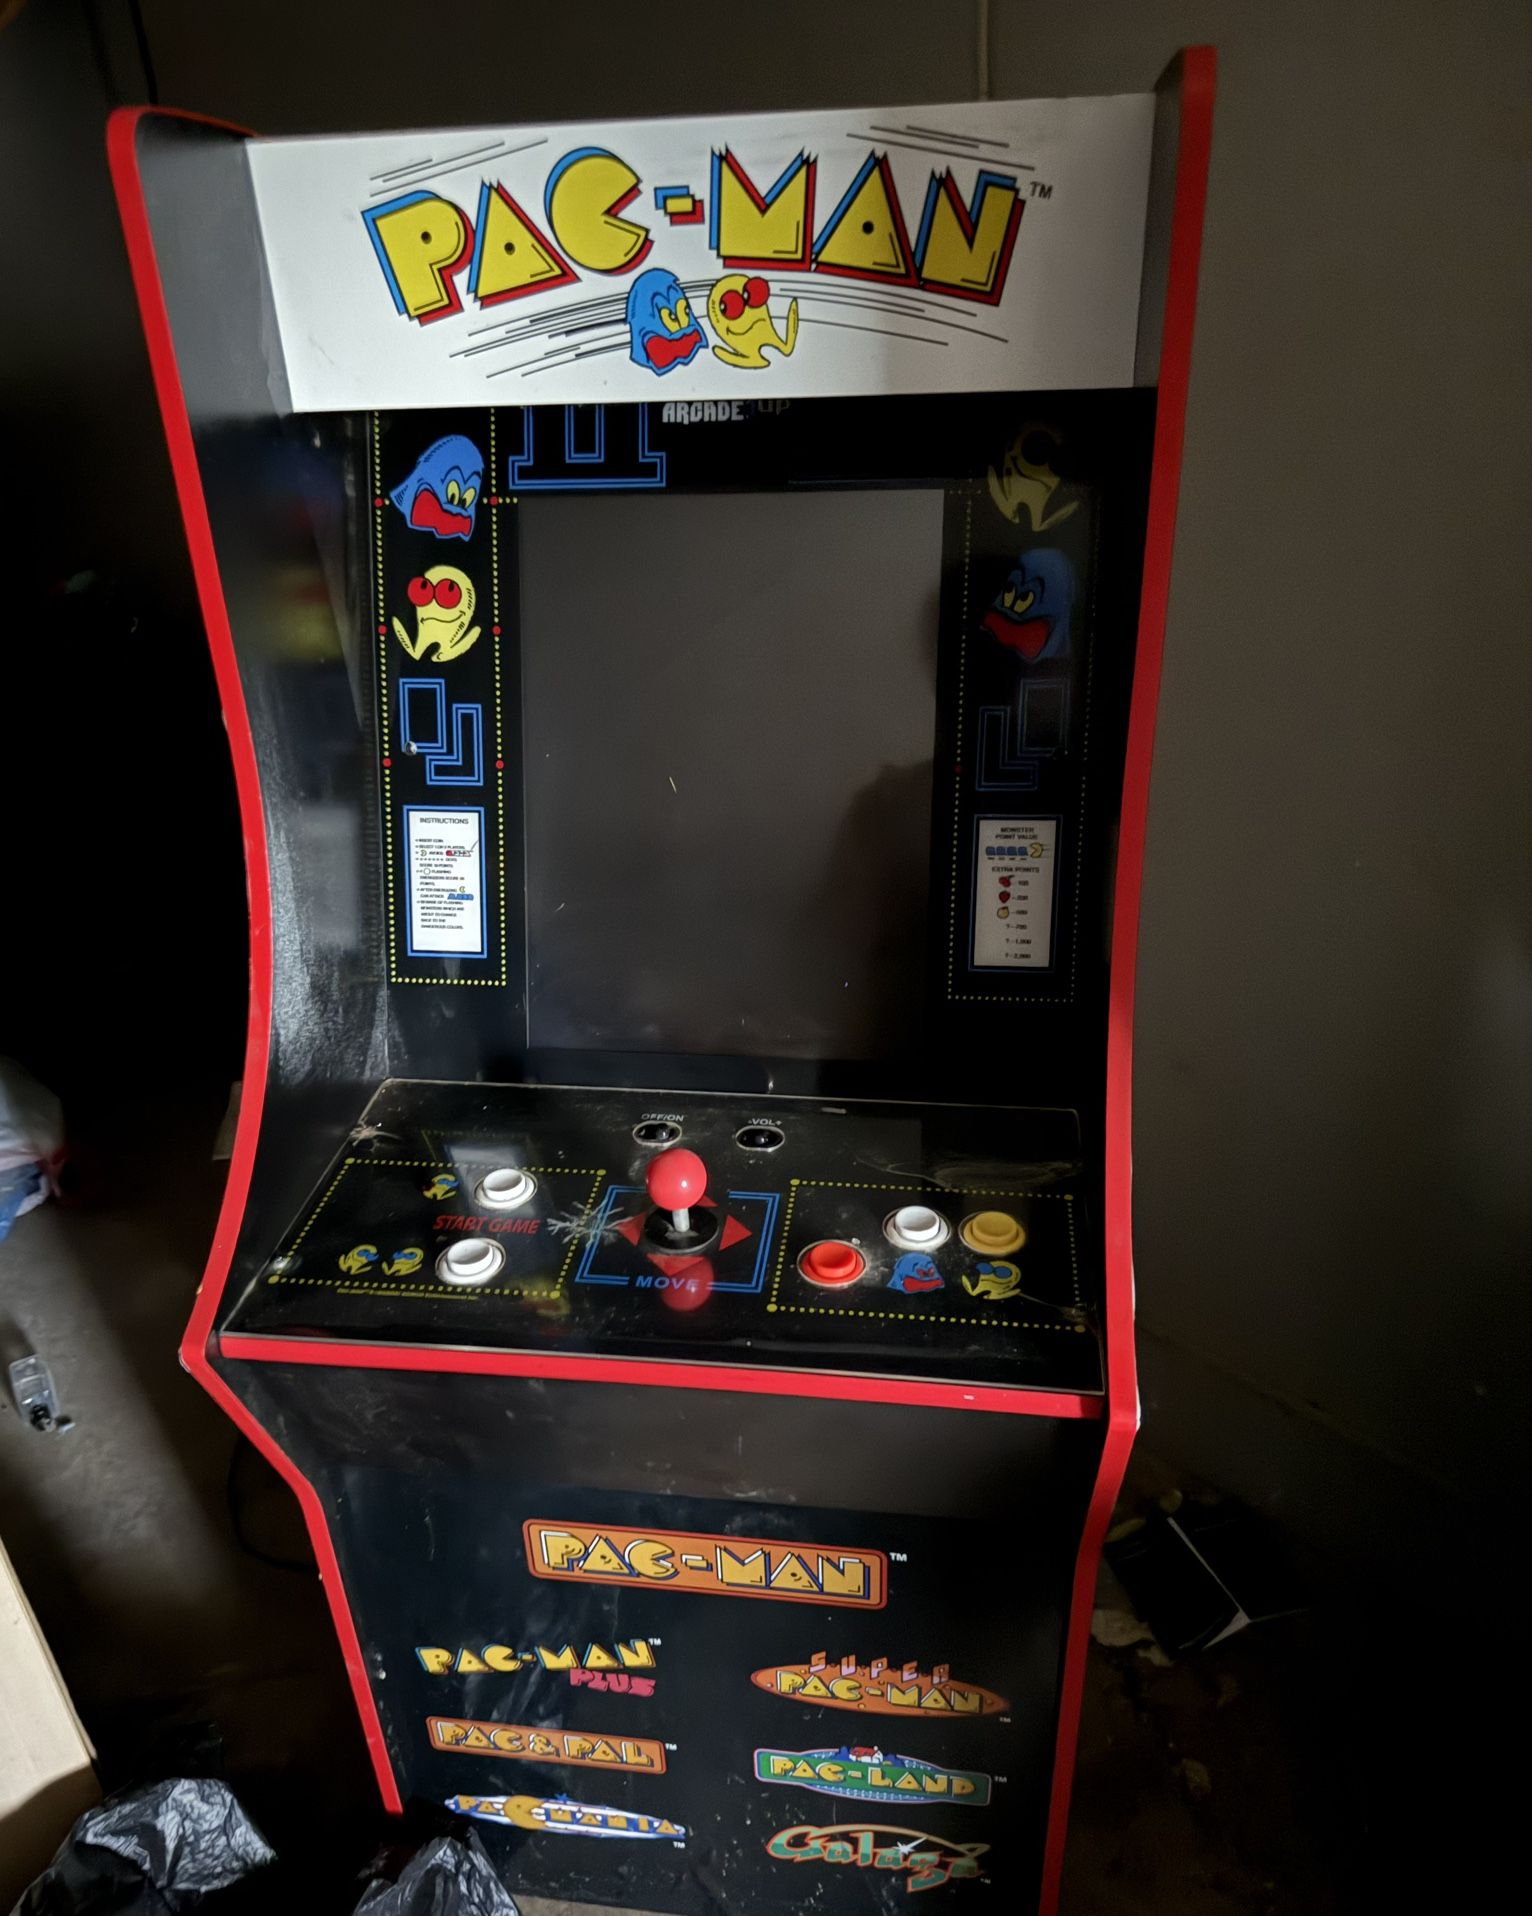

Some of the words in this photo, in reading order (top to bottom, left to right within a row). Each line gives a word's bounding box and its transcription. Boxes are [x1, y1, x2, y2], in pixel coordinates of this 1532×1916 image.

[361, 142, 1026, 326] PAC-MAN
[641, 1113, 685, 1122] OFF/ON
[433, 1215, 486, 1231] START
[489, 1218, 540, 1235] GAME
[635, 1275, 701, 1291] MOVE
[539, 1529, 870, 1600] PAC-MAN
[415, 1638, 656, 1676] PAC-MAN
[808, 1649, 951, 1686] SUPER
[568, 1668, 656, 1697] PLUS
[775, 1670, 985, 1714] PAC-MAN
[770, 1755, 977, 1796] PAC-LAND
